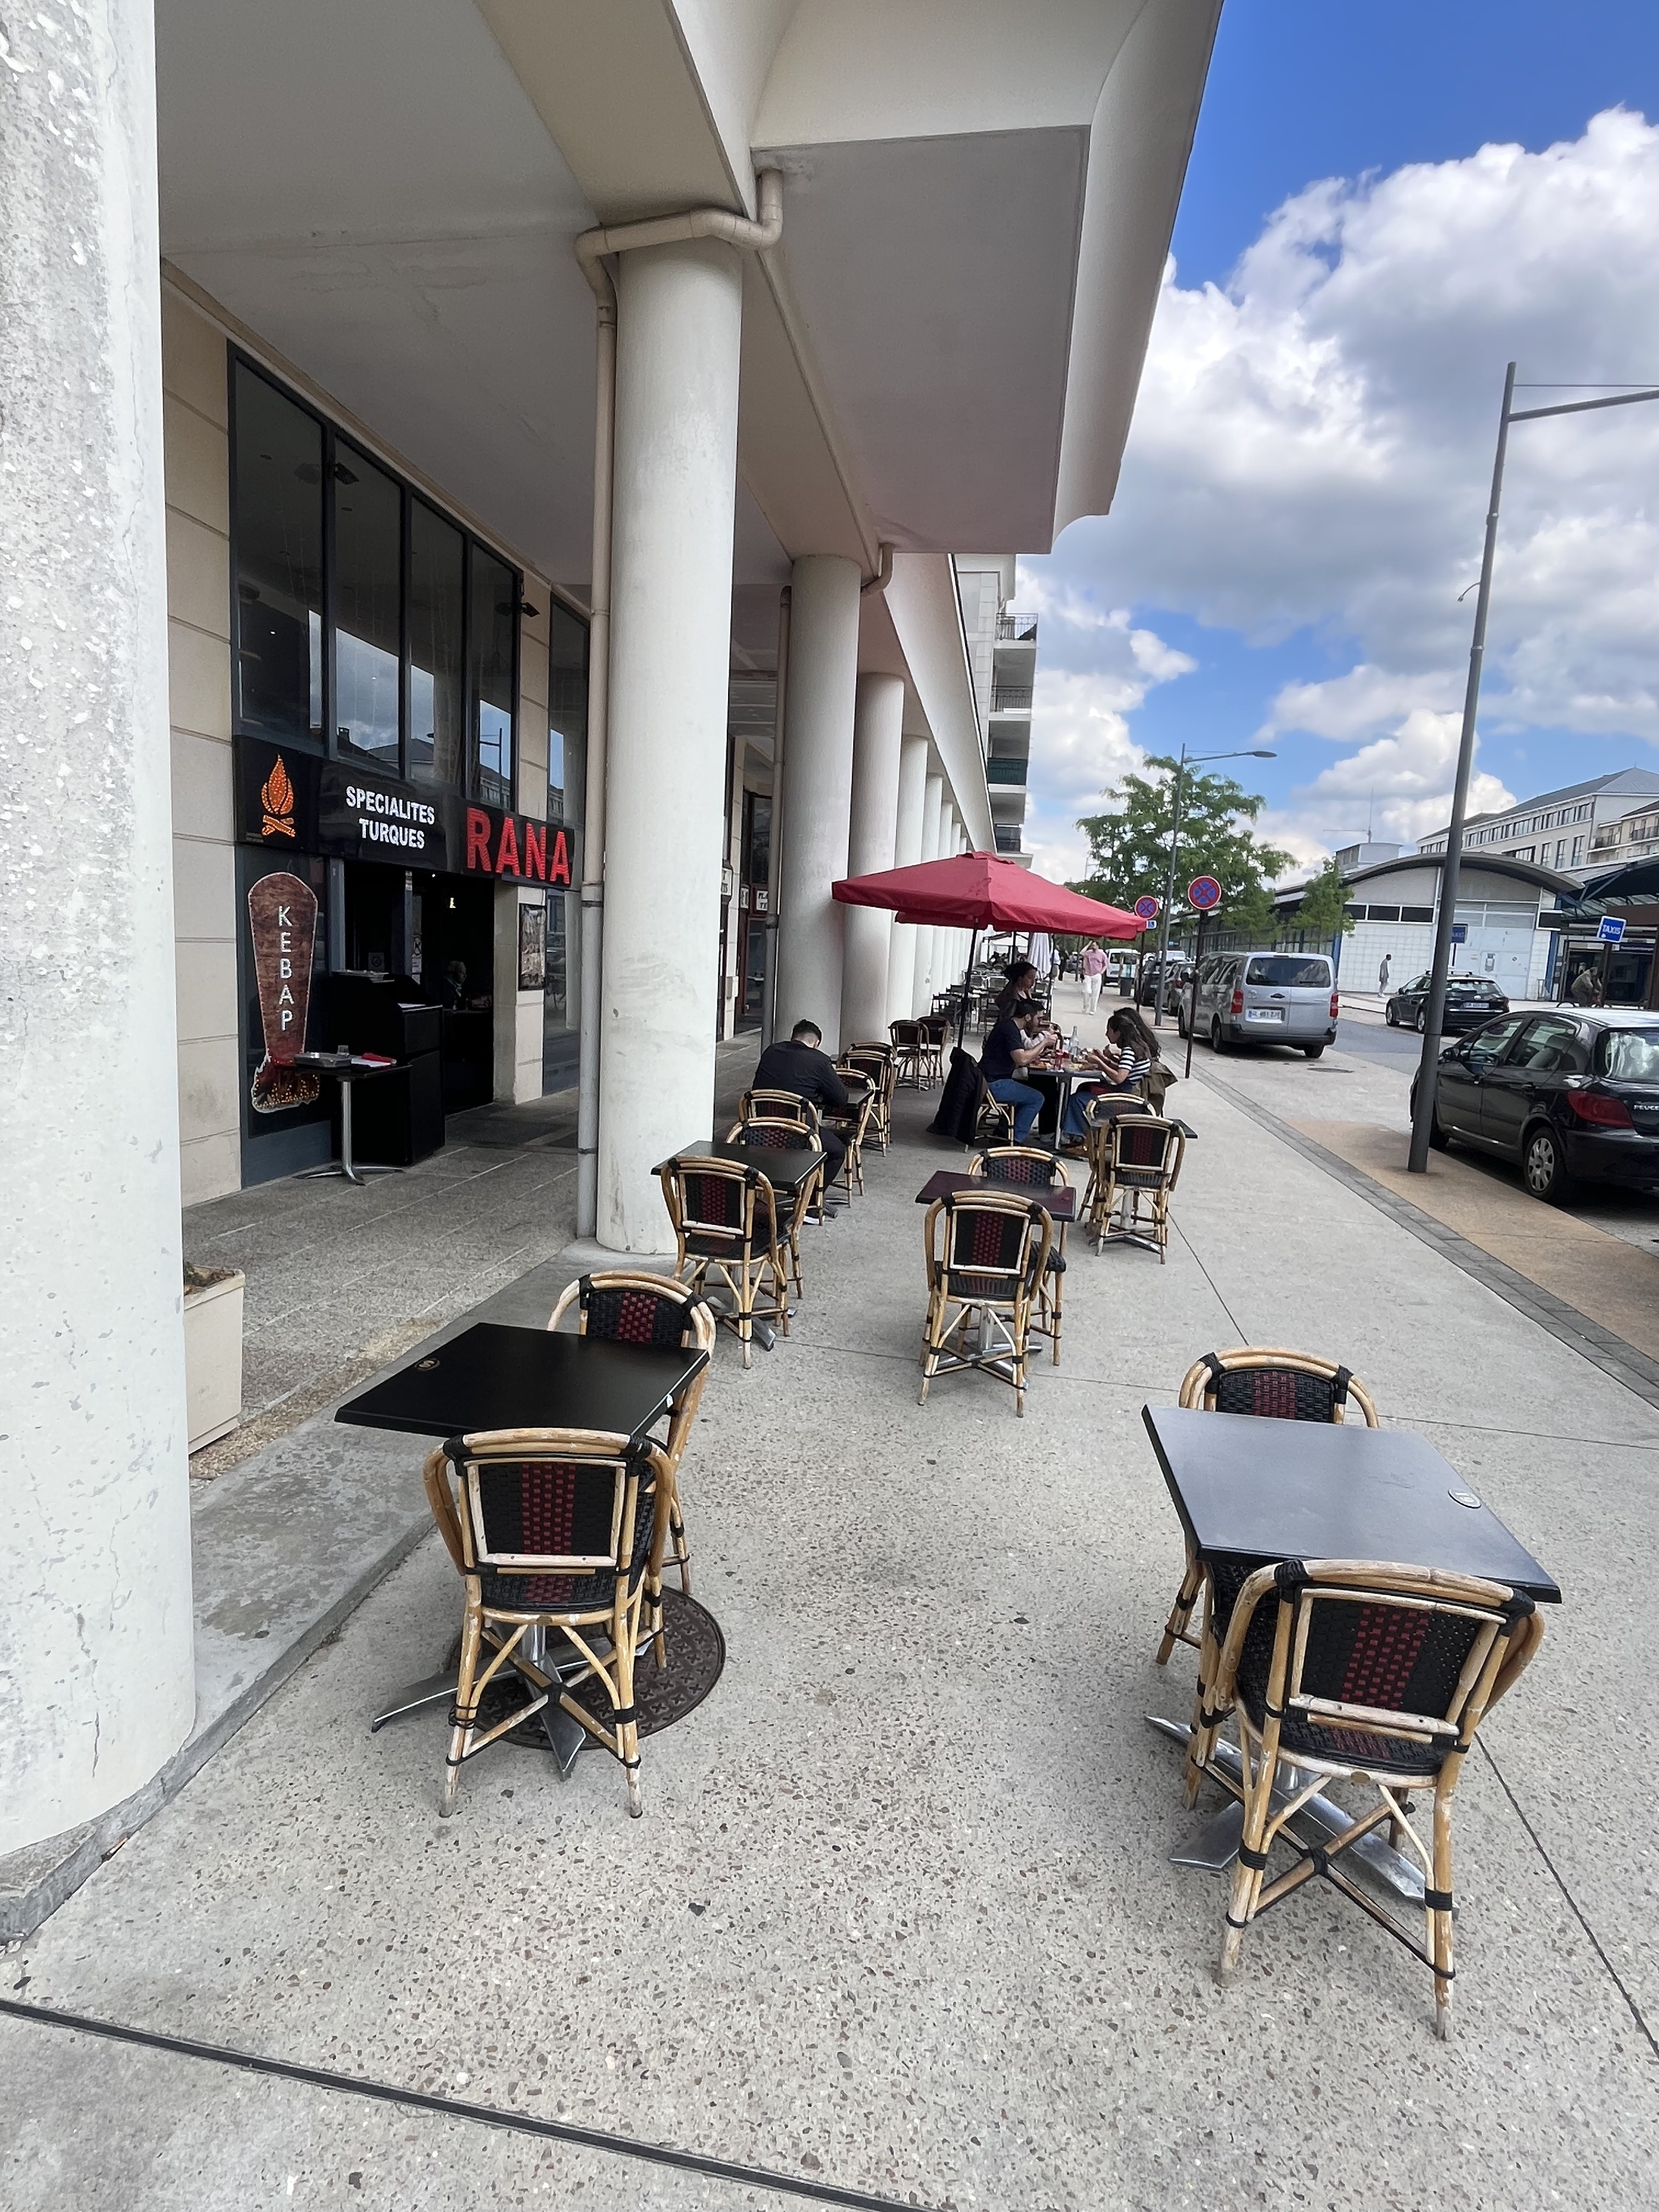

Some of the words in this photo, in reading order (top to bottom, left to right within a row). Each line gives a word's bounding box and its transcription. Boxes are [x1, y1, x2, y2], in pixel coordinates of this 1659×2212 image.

[346, 786, 435, 825] SPECIALITES
[359, 817, 425, 849] TURQUES
[466, 807, 571, 884] RANA
[1602, 924, 1621, 935] TAXIS
[278, 905, 295, 1031] KEBAP
